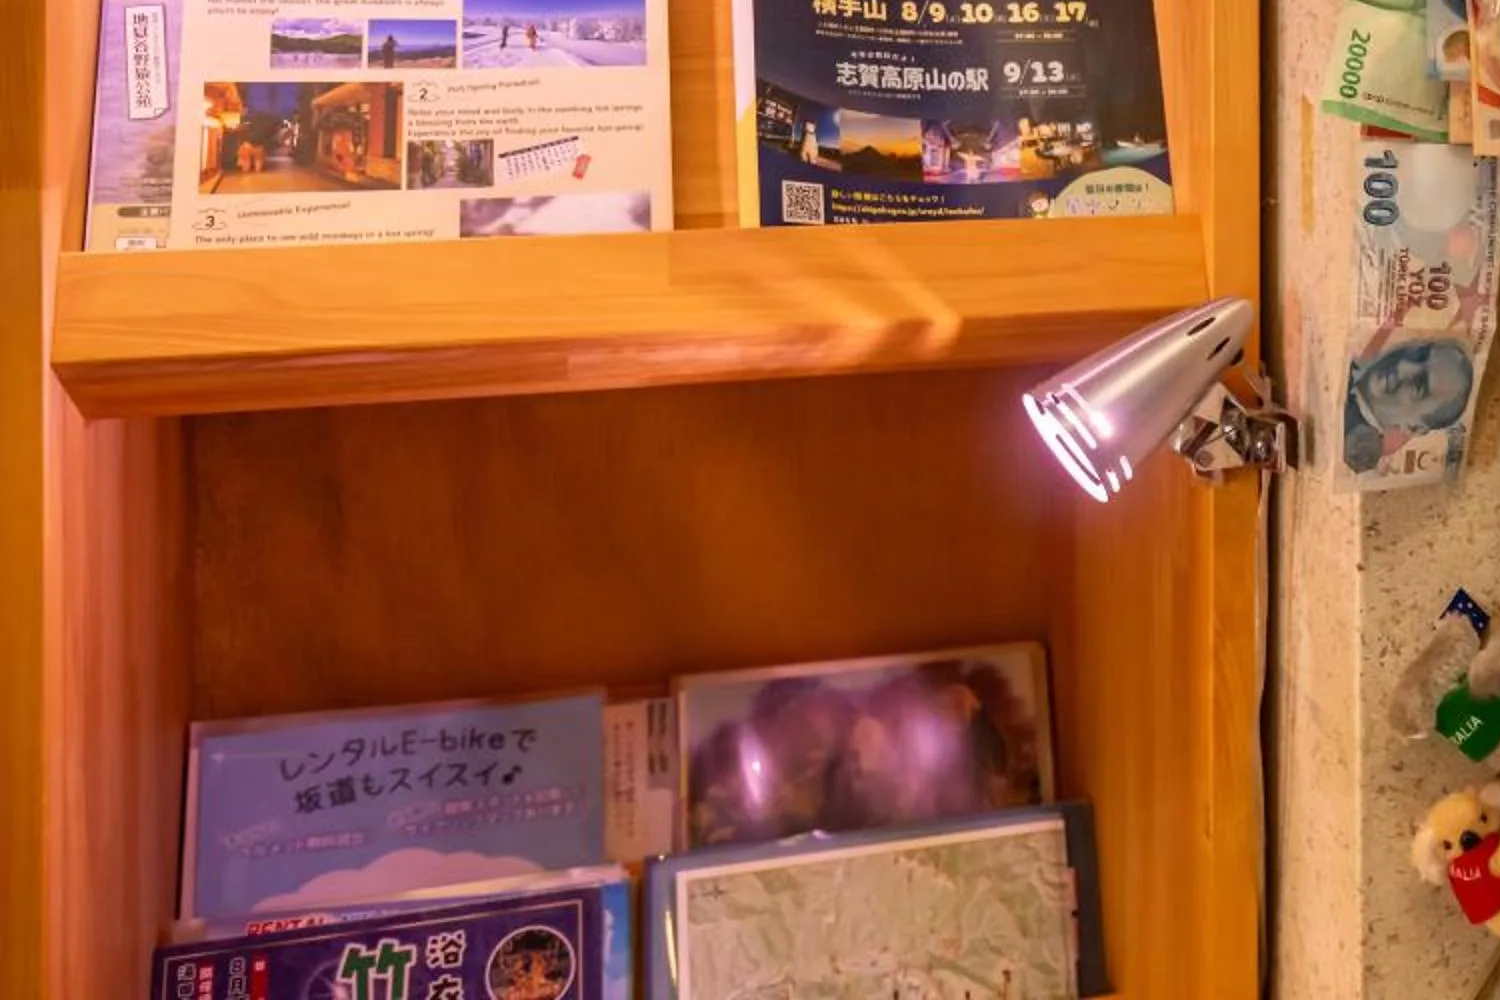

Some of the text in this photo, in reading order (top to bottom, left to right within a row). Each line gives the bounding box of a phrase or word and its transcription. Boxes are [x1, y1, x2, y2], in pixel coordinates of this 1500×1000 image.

[960, 2, 995, 25] 10
[1007, 1, 1041, 24] 16
[1053, 1, 1088, 24] 17
[835, 60, 1066, 92] 志賀高原山の駅 9/13
[1339, 28, 1372, 100] 20000
[418, 86, 429, 101] 2
[1363, 149, 1400, 227] 100
[204, 214, 216, 230] 3
[1425, 261, 1453, 311] 100
